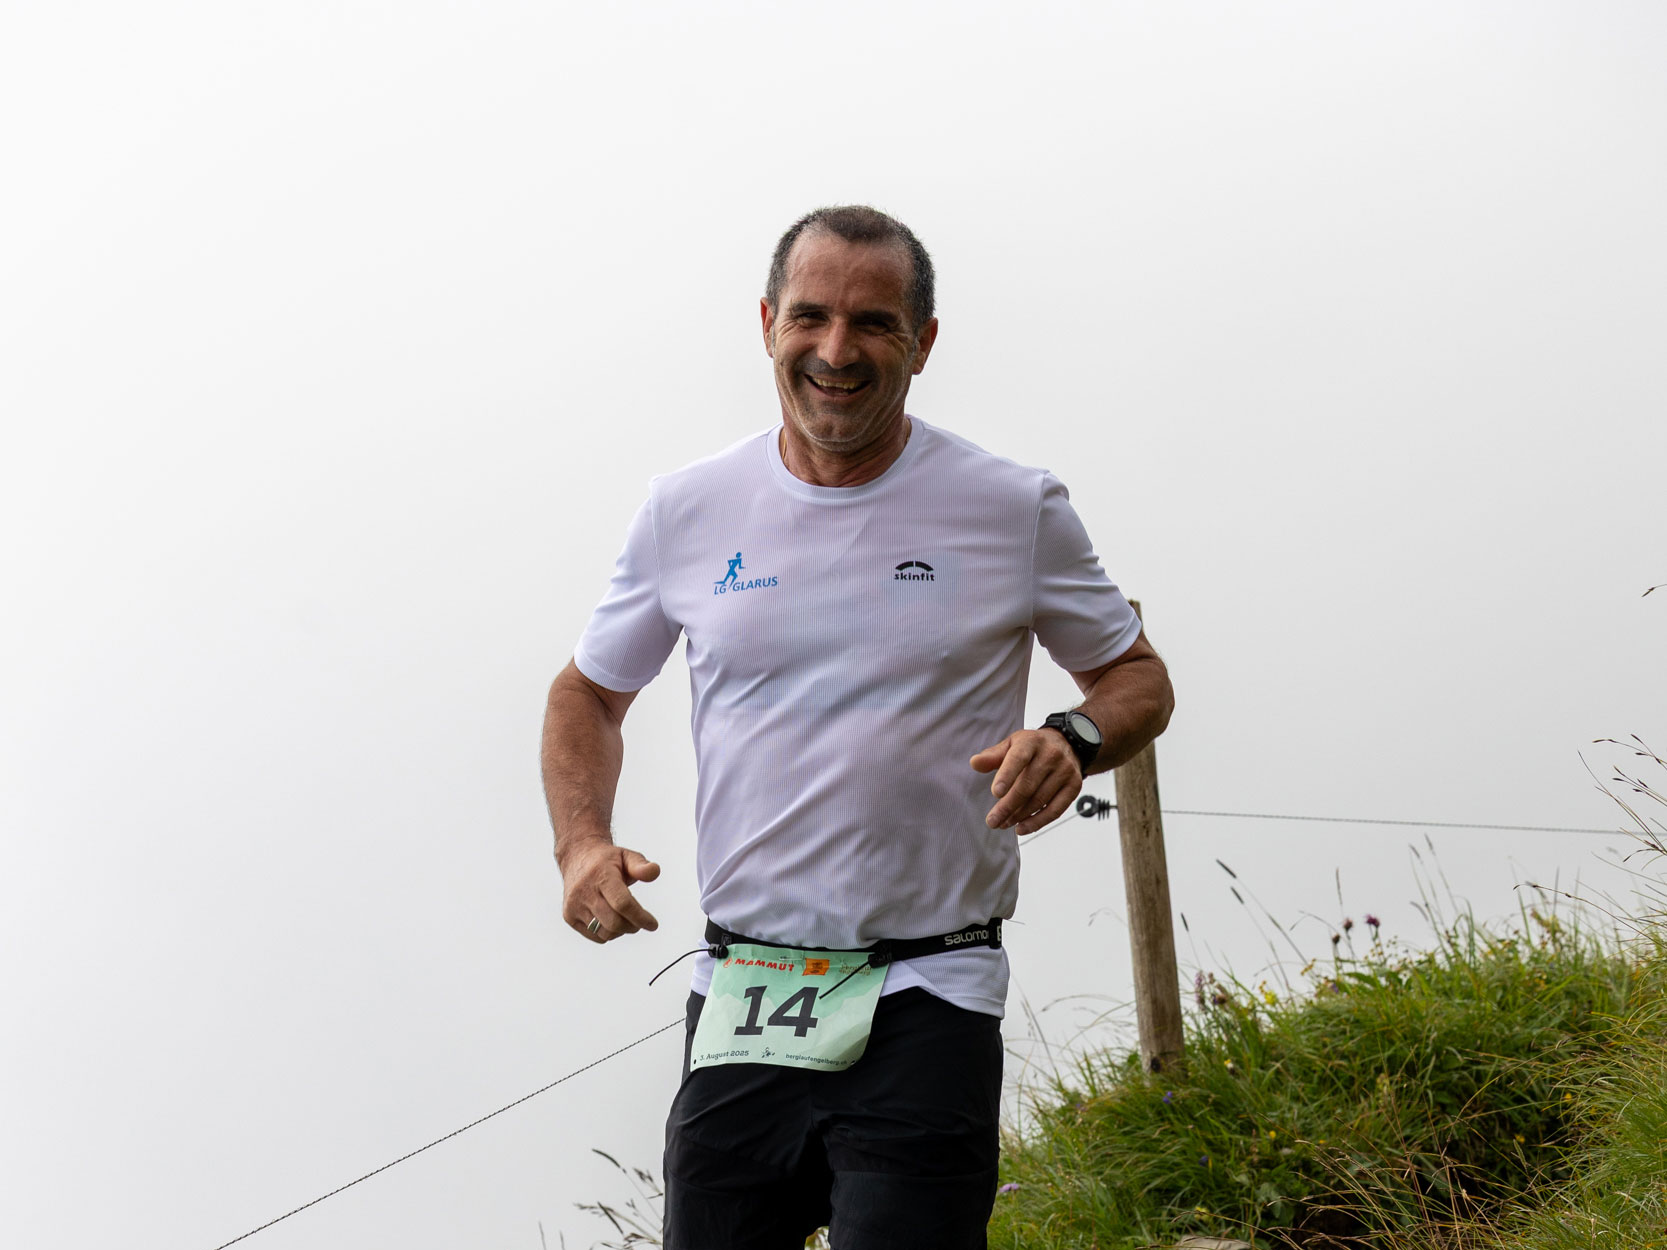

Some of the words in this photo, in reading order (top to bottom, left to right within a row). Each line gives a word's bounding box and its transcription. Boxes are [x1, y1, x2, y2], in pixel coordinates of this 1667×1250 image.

[893, 572, 935, 582] skinfit
[714, 584, 727, 595] LG
[732, 576, 778, 592] GLARUS
[734, 958, 795, 972] MAMMUT
[733, 984, 820, 1038] 14
[706, 1051, 730, 1061] August
